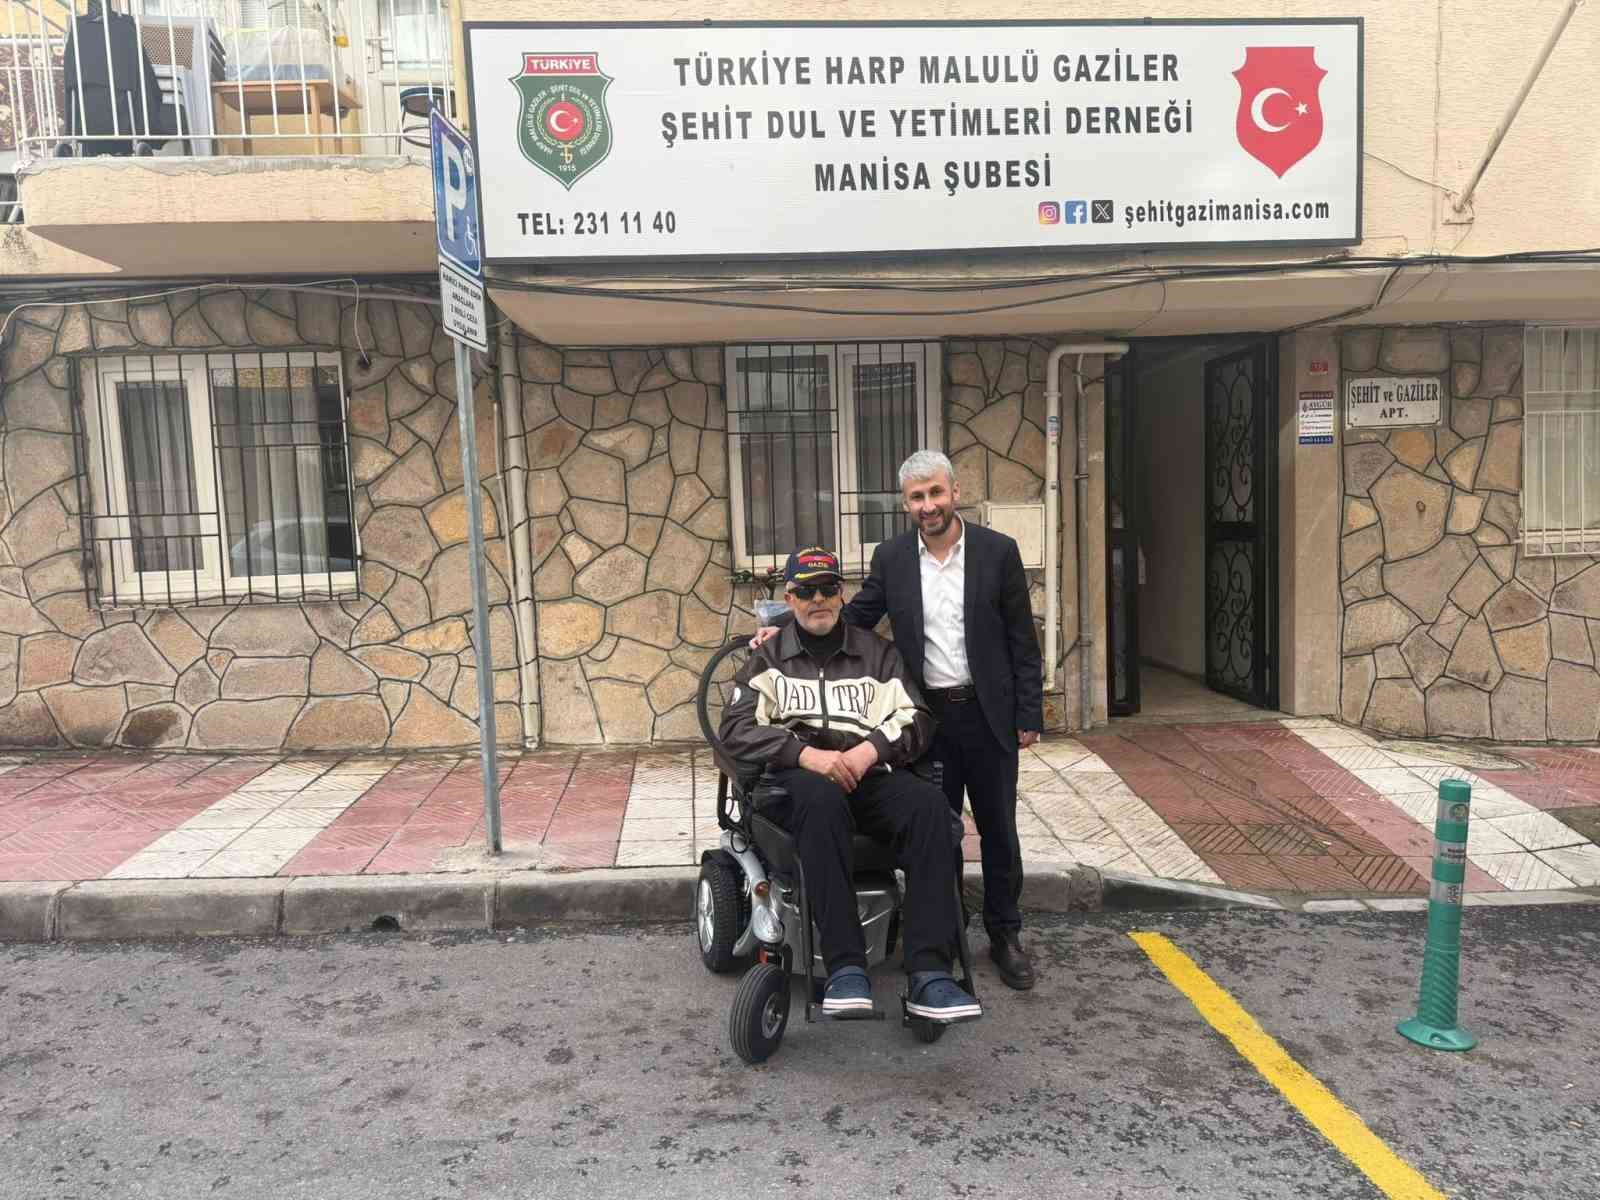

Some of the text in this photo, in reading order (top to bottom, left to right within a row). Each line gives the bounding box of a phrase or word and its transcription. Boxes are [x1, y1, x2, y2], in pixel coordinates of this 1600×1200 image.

[530, 58, 591, 70] TÜRKİYE
[673, 47, 1179, 86] TÜRKİYE HARP MALULÜ GAZİLER
[661, 99, 1192, 149] ŞEHİT DUL VE YETİMLERİ DERNEĞİ
[440, 131, 467, 243] P
[815, 152, 1052, 196] MANİSA ŞUBESİ
[517, 211, 676, 236] TEL: 231 11 40
[1125, 198, 1330, 229] şehitgazimanisa.com
[1350, 381, 1380, 408] ŞEHİT
[1383, 391, 1393, 402] ve
[1396, 380, 1438, 402] GAZİLER
[1379, 407, 1409, 419] APT.
[832, 681, 875, 719] TRIP
